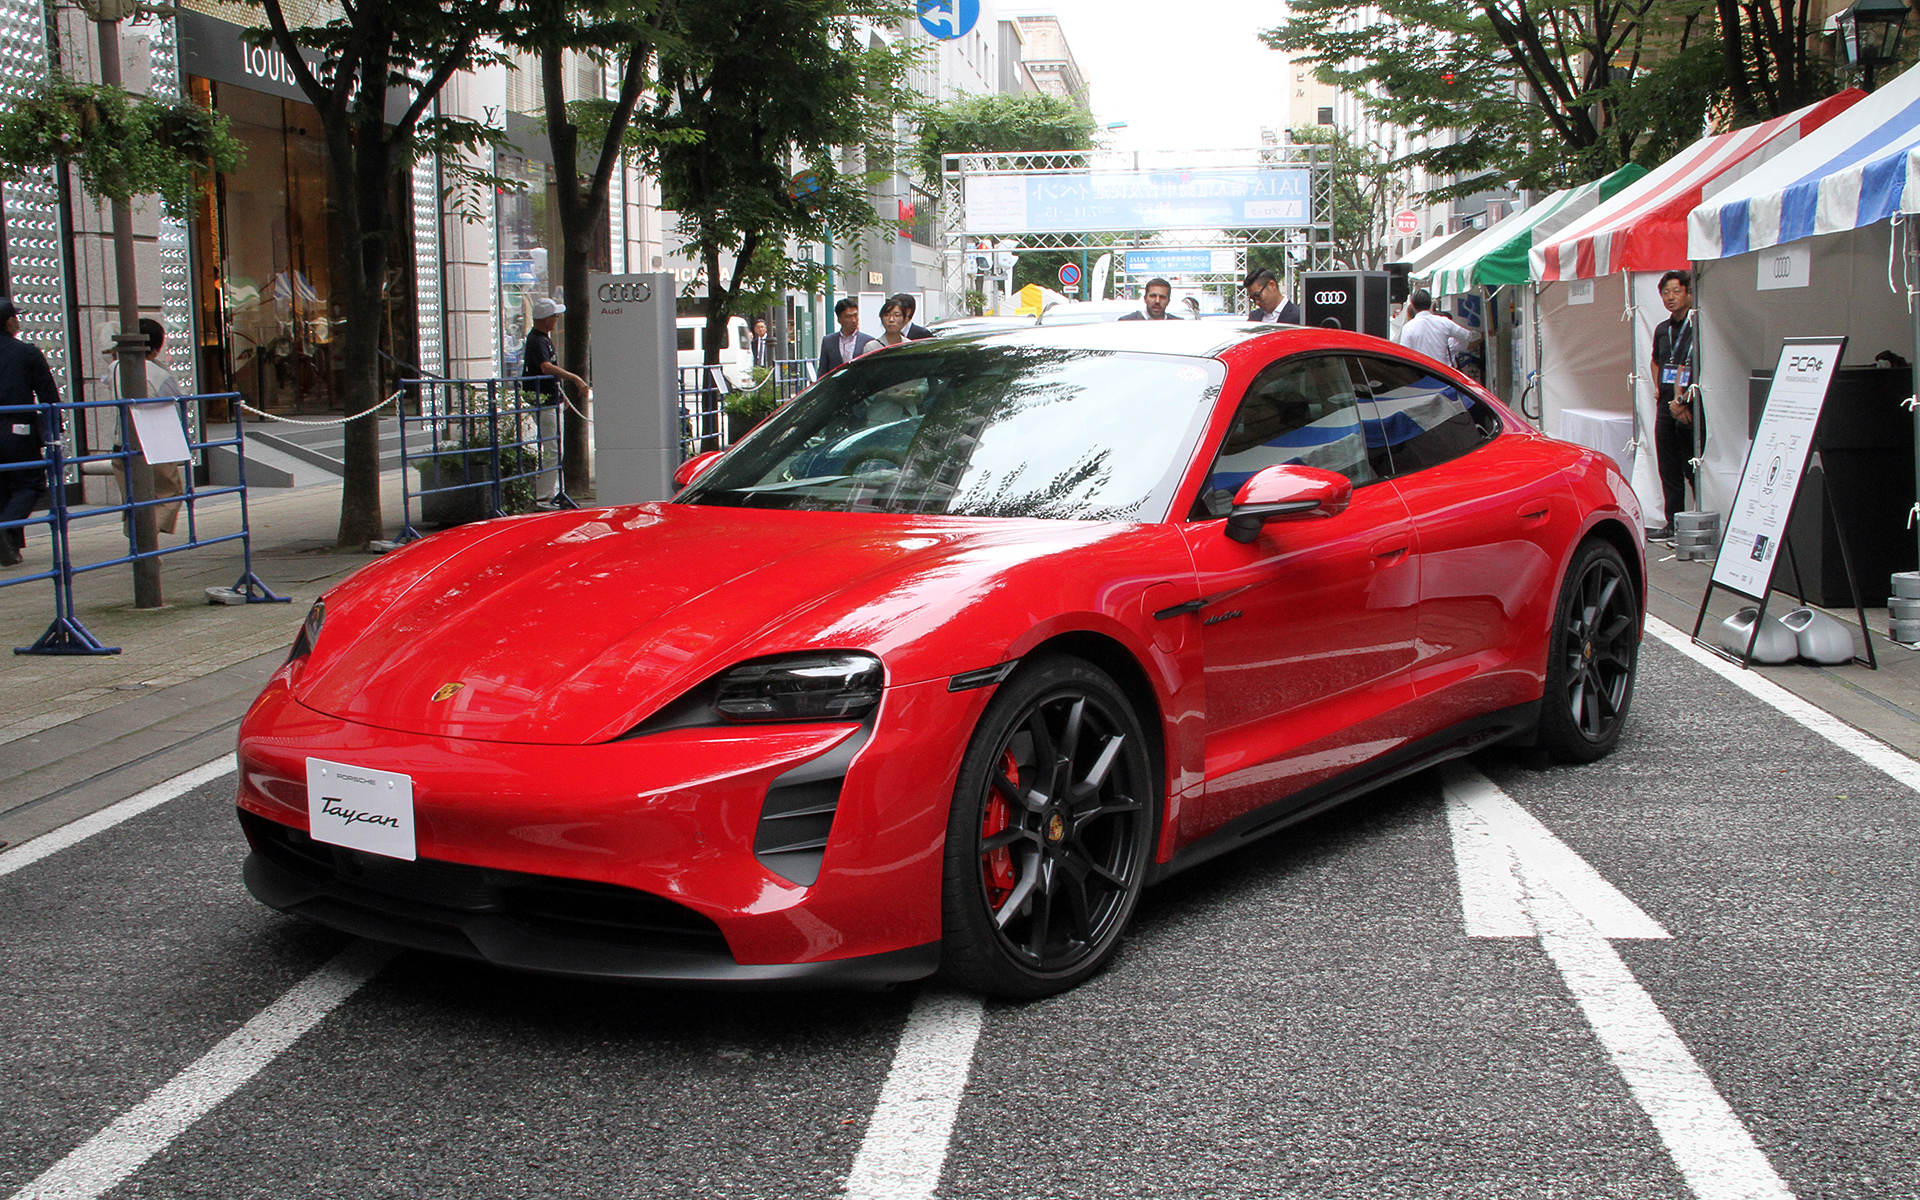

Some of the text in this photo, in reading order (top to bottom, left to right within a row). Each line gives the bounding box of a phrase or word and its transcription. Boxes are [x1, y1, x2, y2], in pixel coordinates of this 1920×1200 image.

[242, 40, 297, 86] LOUIS
[601, 307, 623, 315] Audi
[1788, 356, 1817, 372] PCA
[336, 773, 377, 786] PORSCHE
[321, 796, 400, 828] Taycan
